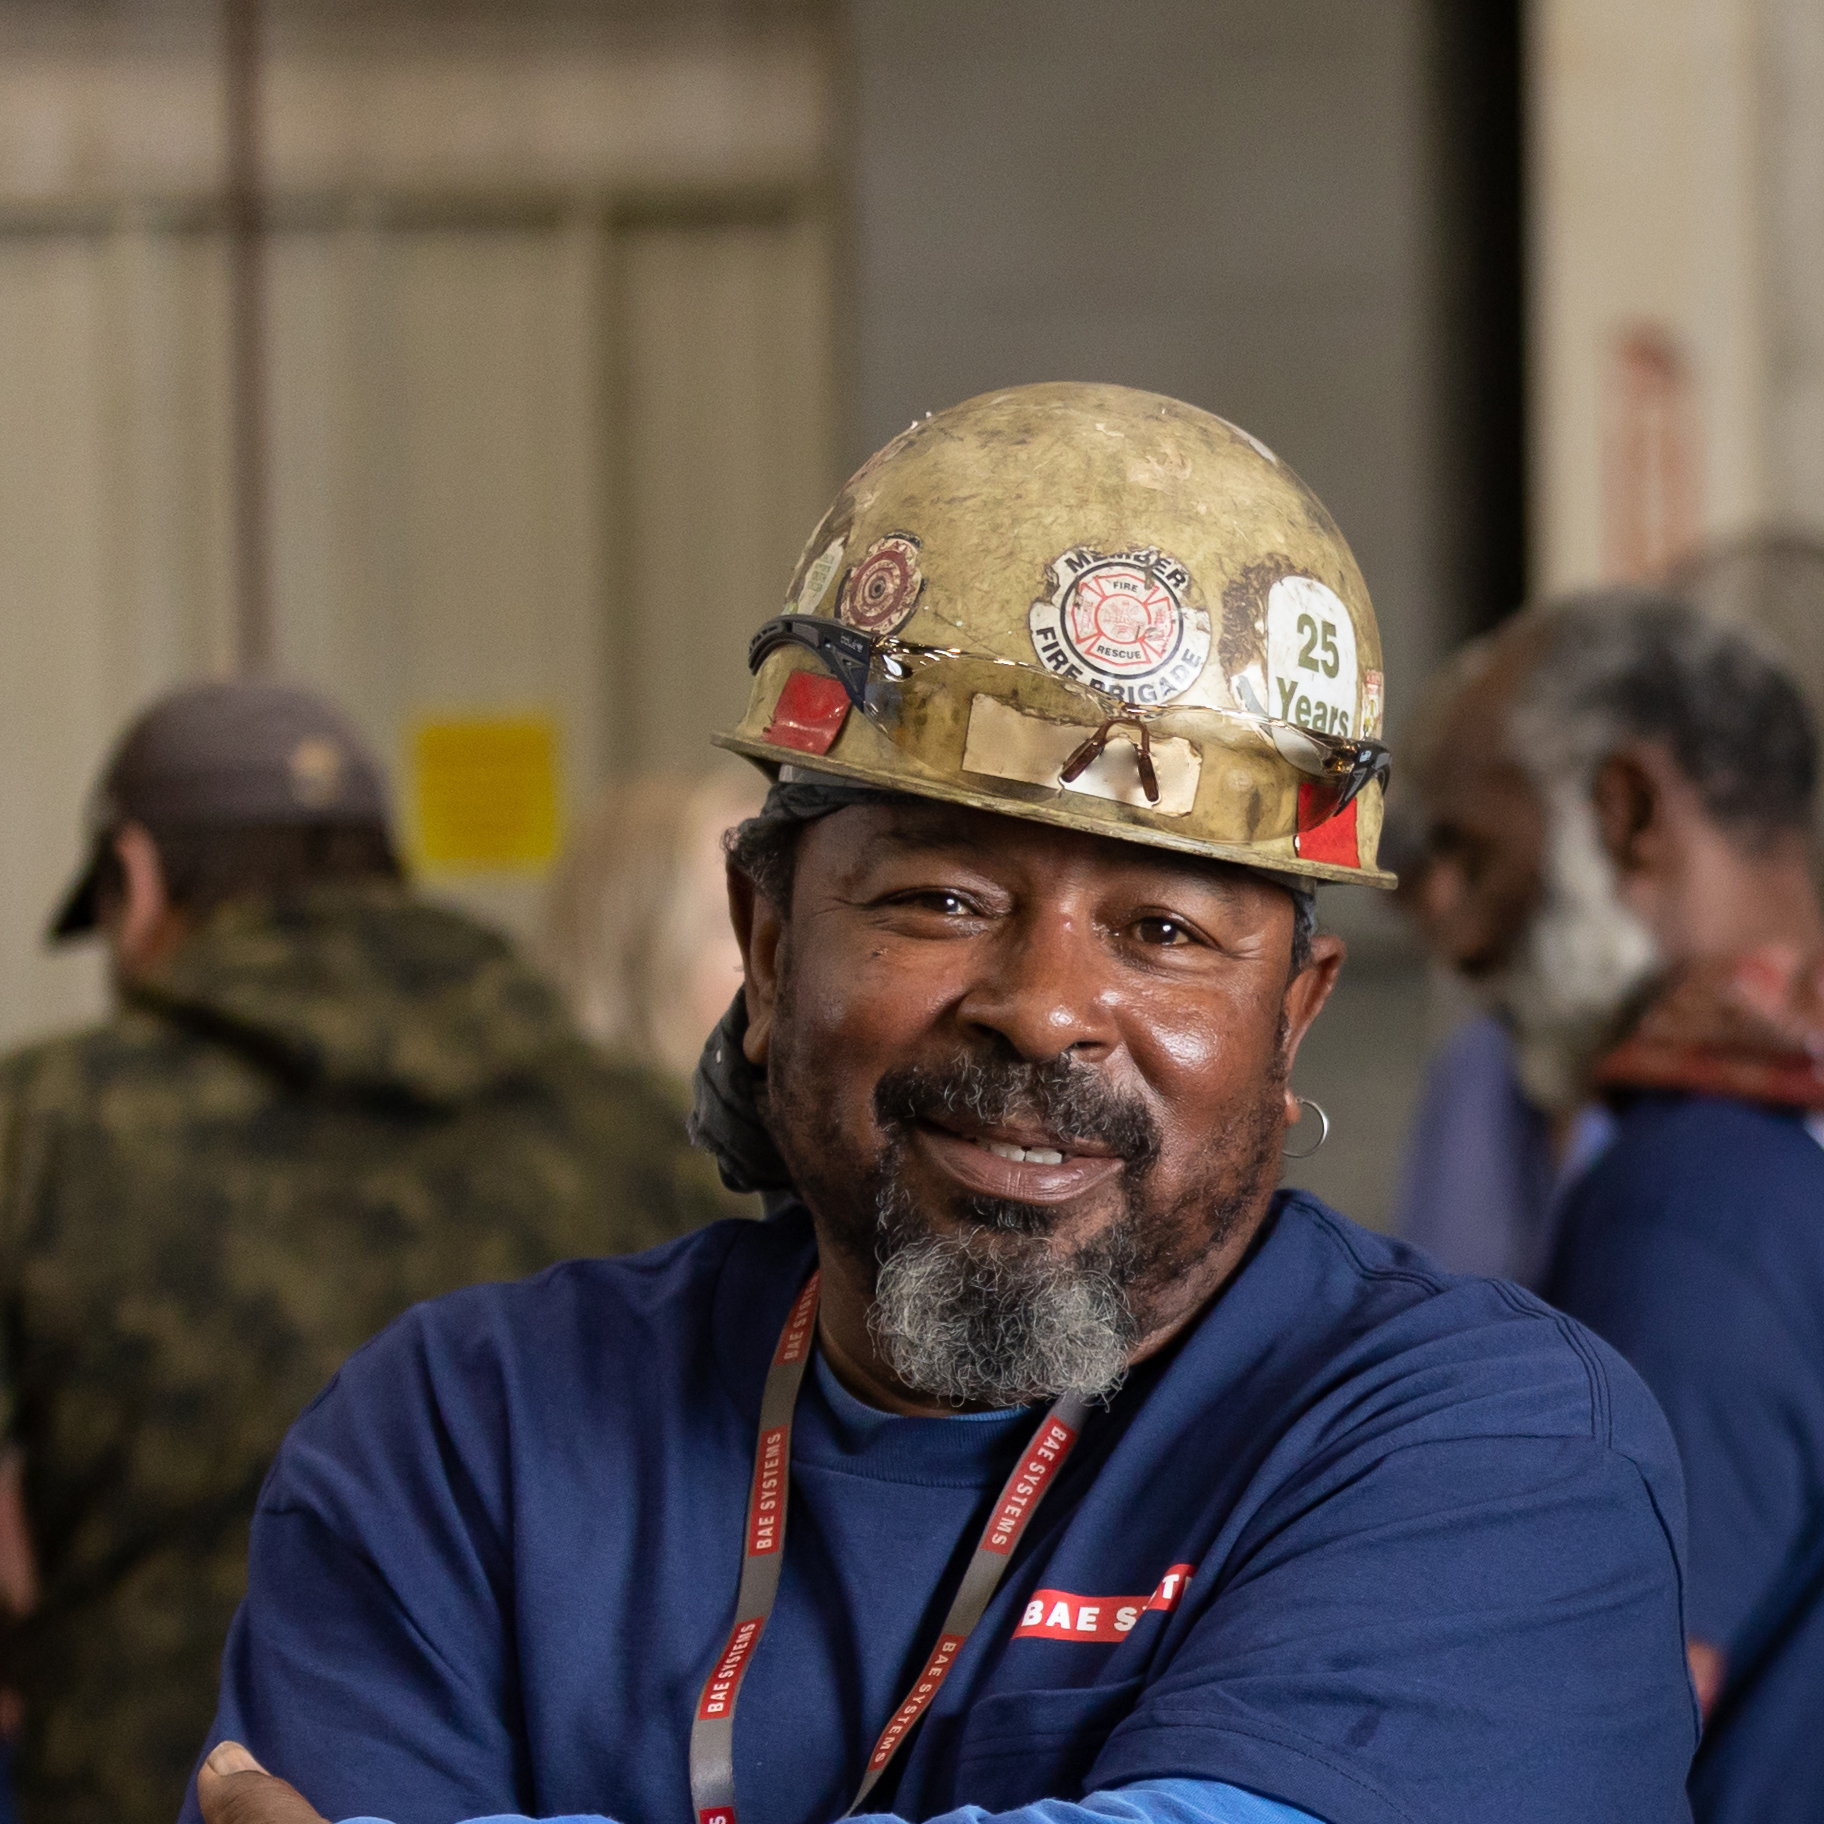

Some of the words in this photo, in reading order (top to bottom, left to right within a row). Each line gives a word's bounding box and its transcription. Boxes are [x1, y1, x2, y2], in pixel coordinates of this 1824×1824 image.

[1113, 581, 1138, 593] FIRE
[1036, 626, 1084, 680] FIRE
[1096, 645, 1142, 660] RESCUE
[1296, 613, 1339, 679] 25
[1276, 676, 1348, 737] Years
[784, 1331, 803, 1361] BAE
[1037, 1426, 1067, 1461] BAE
[760, 1433, 781, 1509] SYSTEMS
[992, 1461, 1046, 1545] SYSTEMS
[757, 1514, 775, 1549] BAE
[1021, 1600, 1100, 1632] BAE
[707, 1682, 730, 1713] BAE
[719, 1622, 756, 1677] SYSTEMS
[928, 1641, 957, 1677] BAE
[875, 1683, 932, 1763] SYSTEMS
